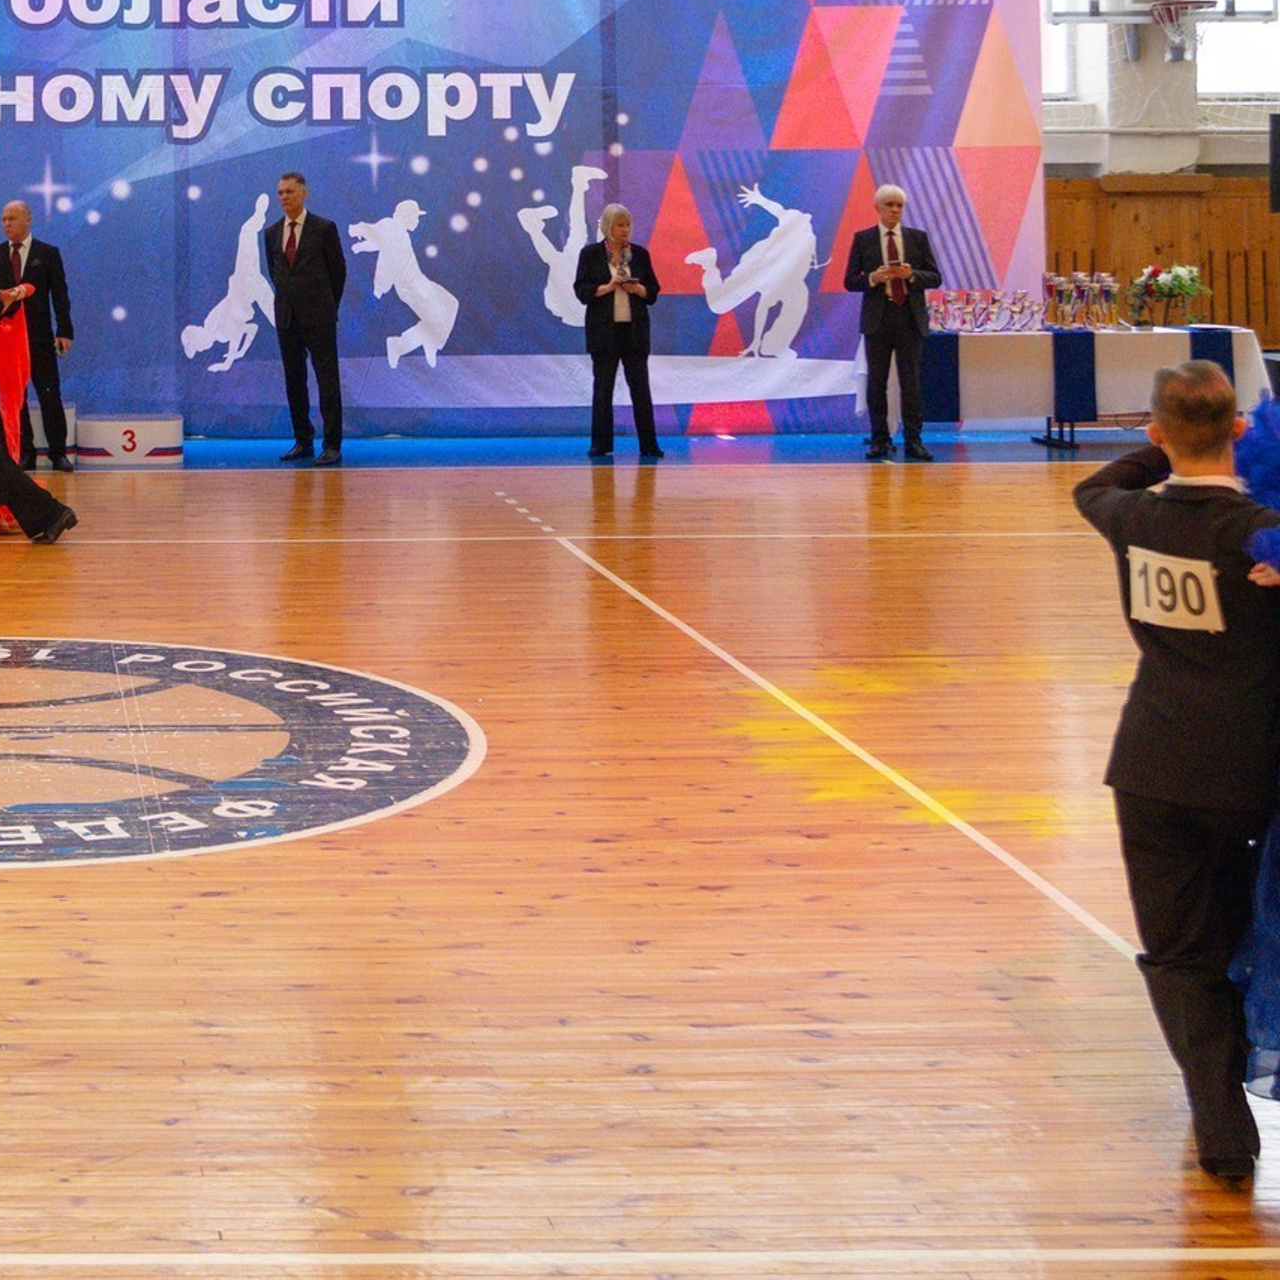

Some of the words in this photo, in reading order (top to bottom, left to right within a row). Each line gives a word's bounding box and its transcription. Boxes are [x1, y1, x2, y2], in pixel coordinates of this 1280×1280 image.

[250, 70, 577, 138] спорту
[121, 429, 138, 453] 3
[1136, 561, 1206, 616] 190
[116, 653, 411, 792] РОССИЙСКАЯ
